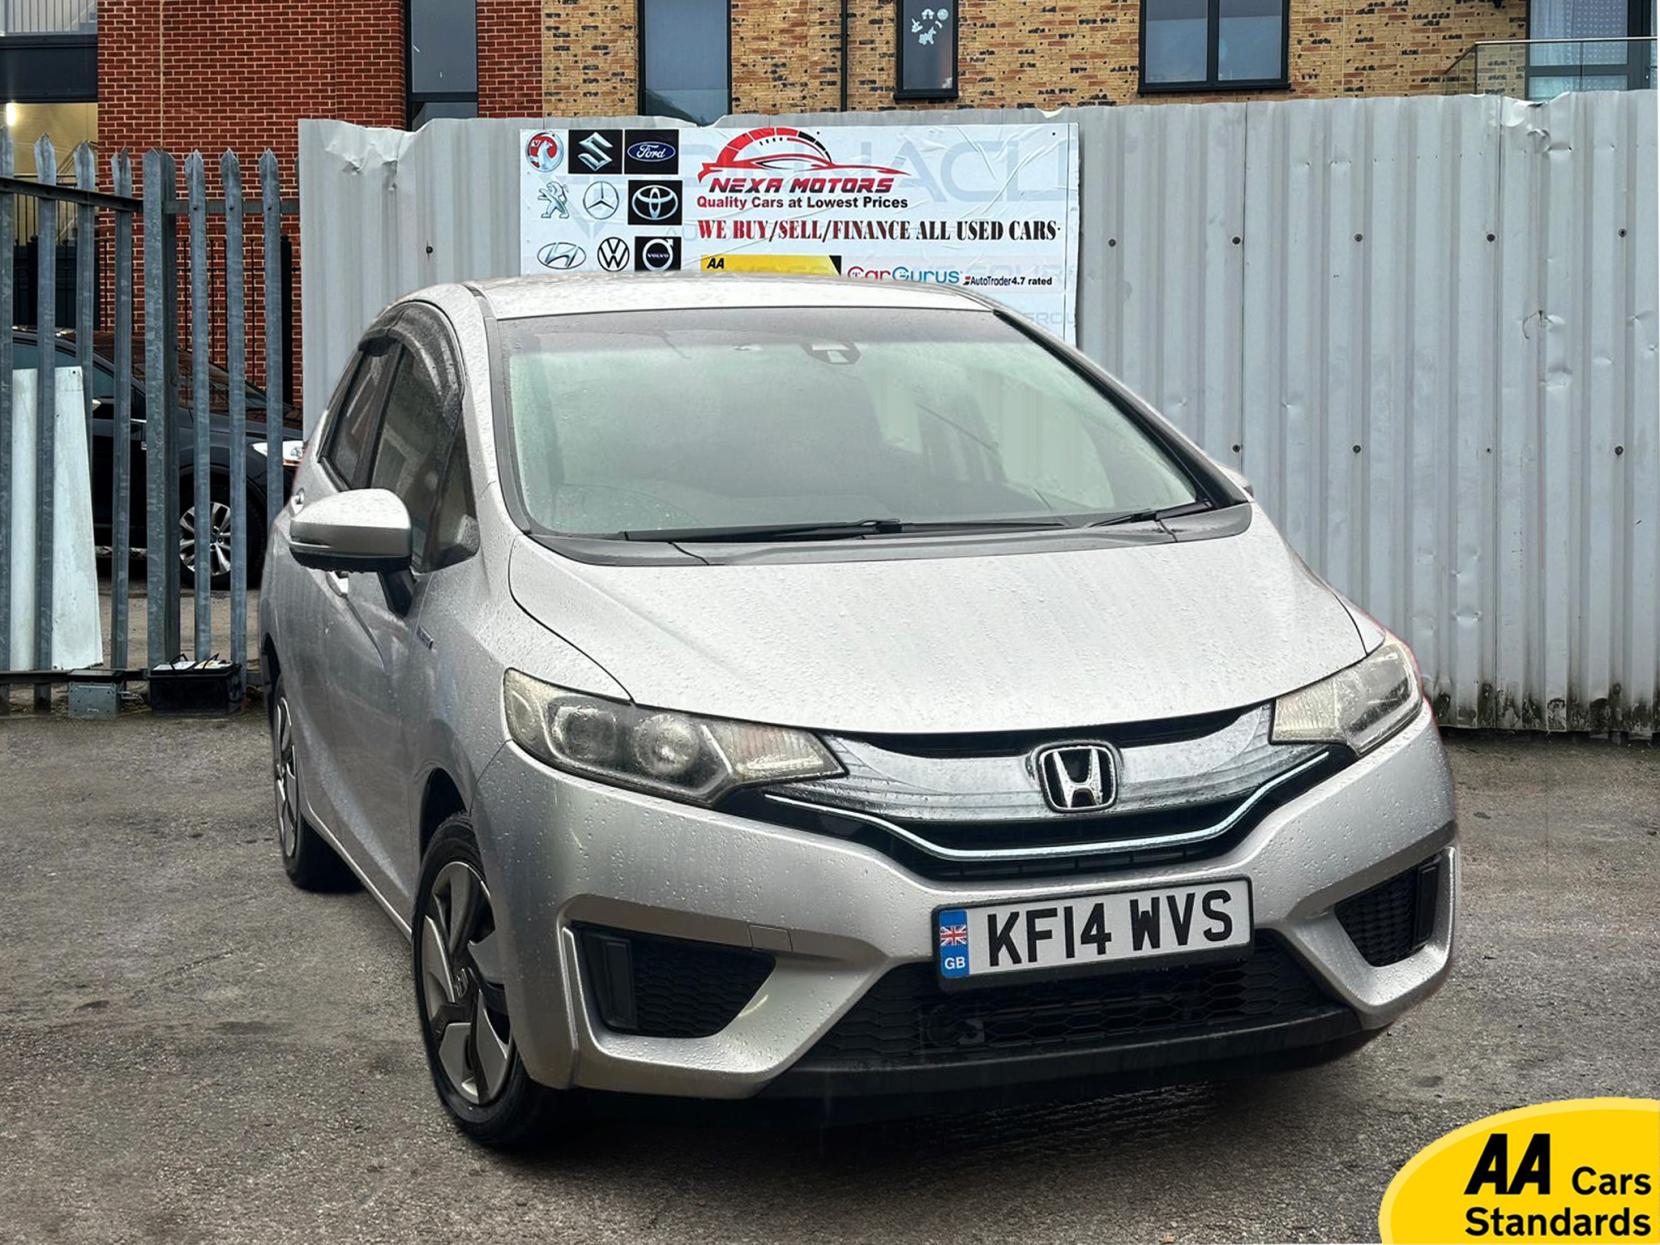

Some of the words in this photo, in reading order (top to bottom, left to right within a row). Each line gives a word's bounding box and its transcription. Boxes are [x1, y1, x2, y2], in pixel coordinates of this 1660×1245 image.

[636, 143, 669, 160] Ford
[709, 177, 784, 194] NEXA
[789, 177, 895, 193] MOTORS
[697, 195, 747, 210] Quality
[751, 196, 784, 208] Cars
[788, 197, 802, 208] at
[807, 196, 859, 208] Lowest
[863, 196, 908, 208] Prices
[698, 219, 727, 240] WE
[732, 219, 911, 242] BUY/SELL/FINANCE
[915, 220, 951, 240] ALL
[956, 220, 1004, 241] USED
[1008, 220, 1057, 241] CARS
[706, 257, 726, 269] AA
[1027, 277, 1053, 286] rated
[986, 902, 1112, 967] KF14
[1129, 889, 1233, 951] WVS
[944, 956, 966, 971] GB
